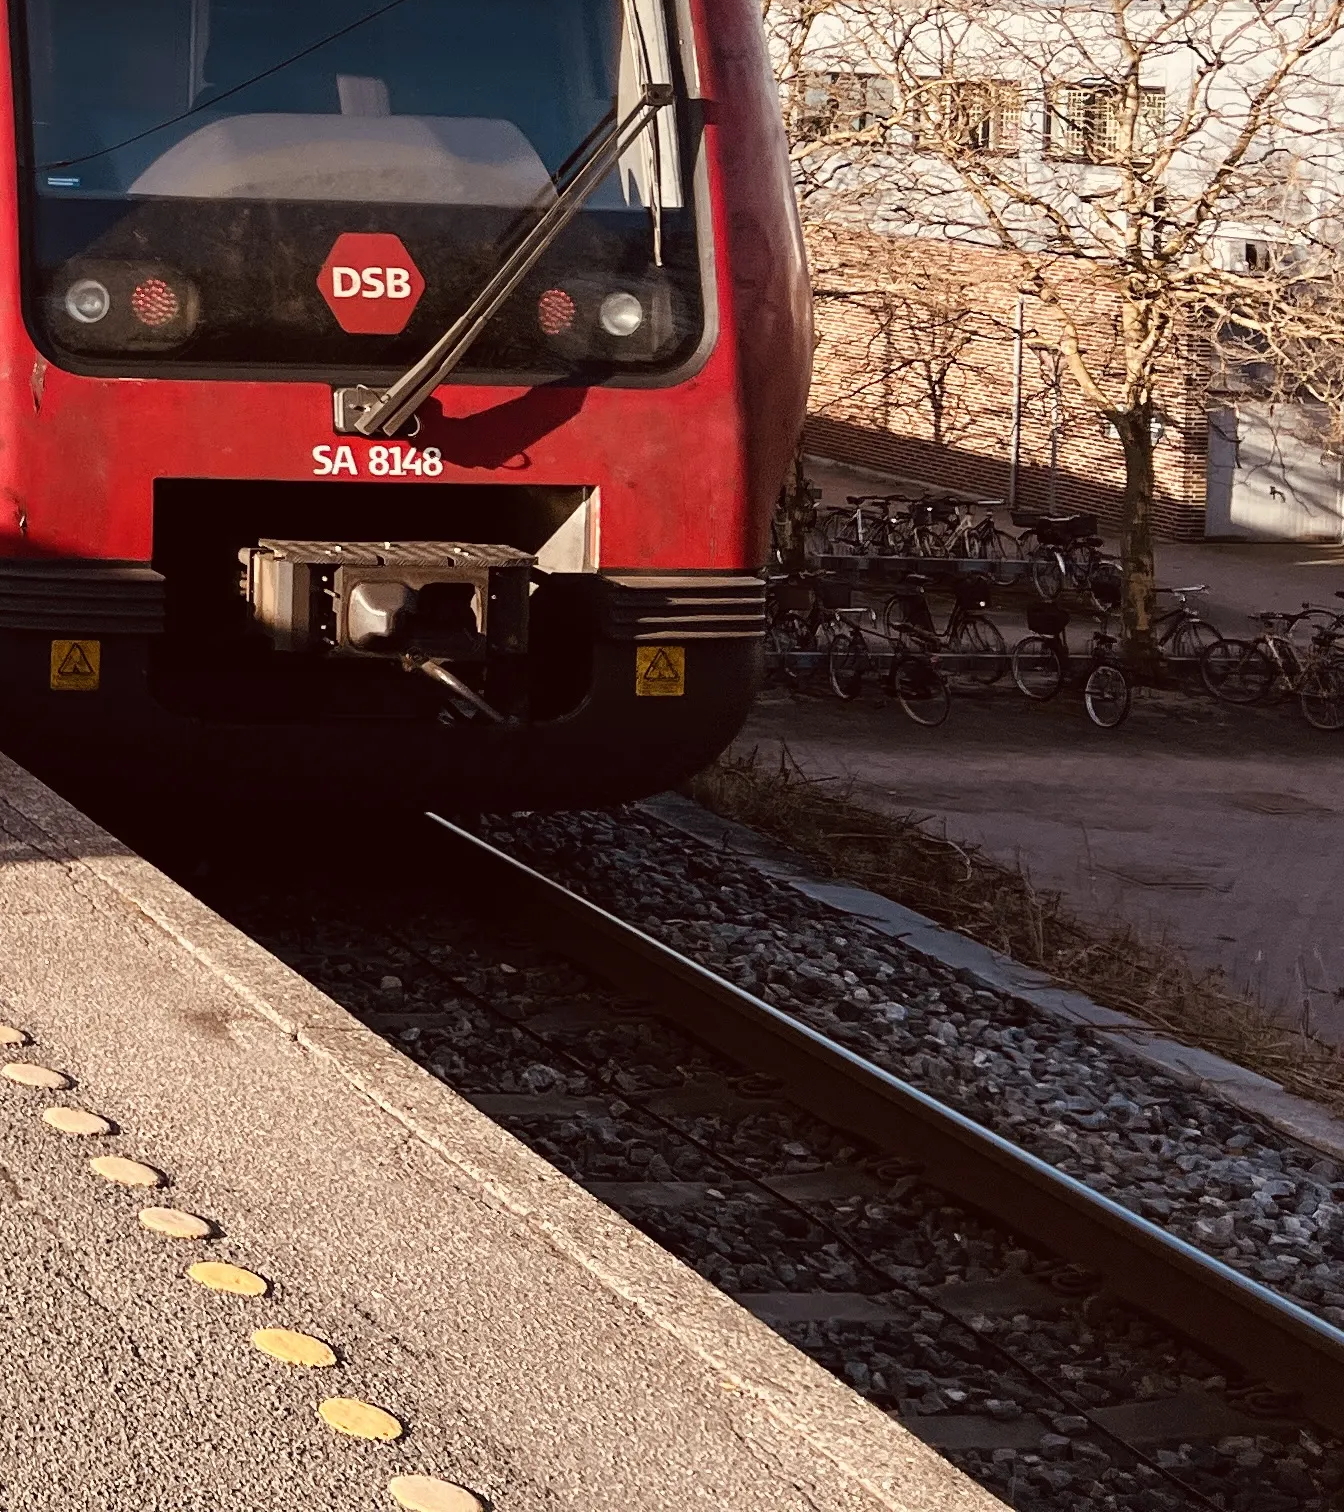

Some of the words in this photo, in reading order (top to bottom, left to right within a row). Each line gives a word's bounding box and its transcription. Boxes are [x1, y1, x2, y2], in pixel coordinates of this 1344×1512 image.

[332, 266, 412, 299] DSB
[312, 444, 360, 477] SA
[367, 445, 444, 477] 8148
